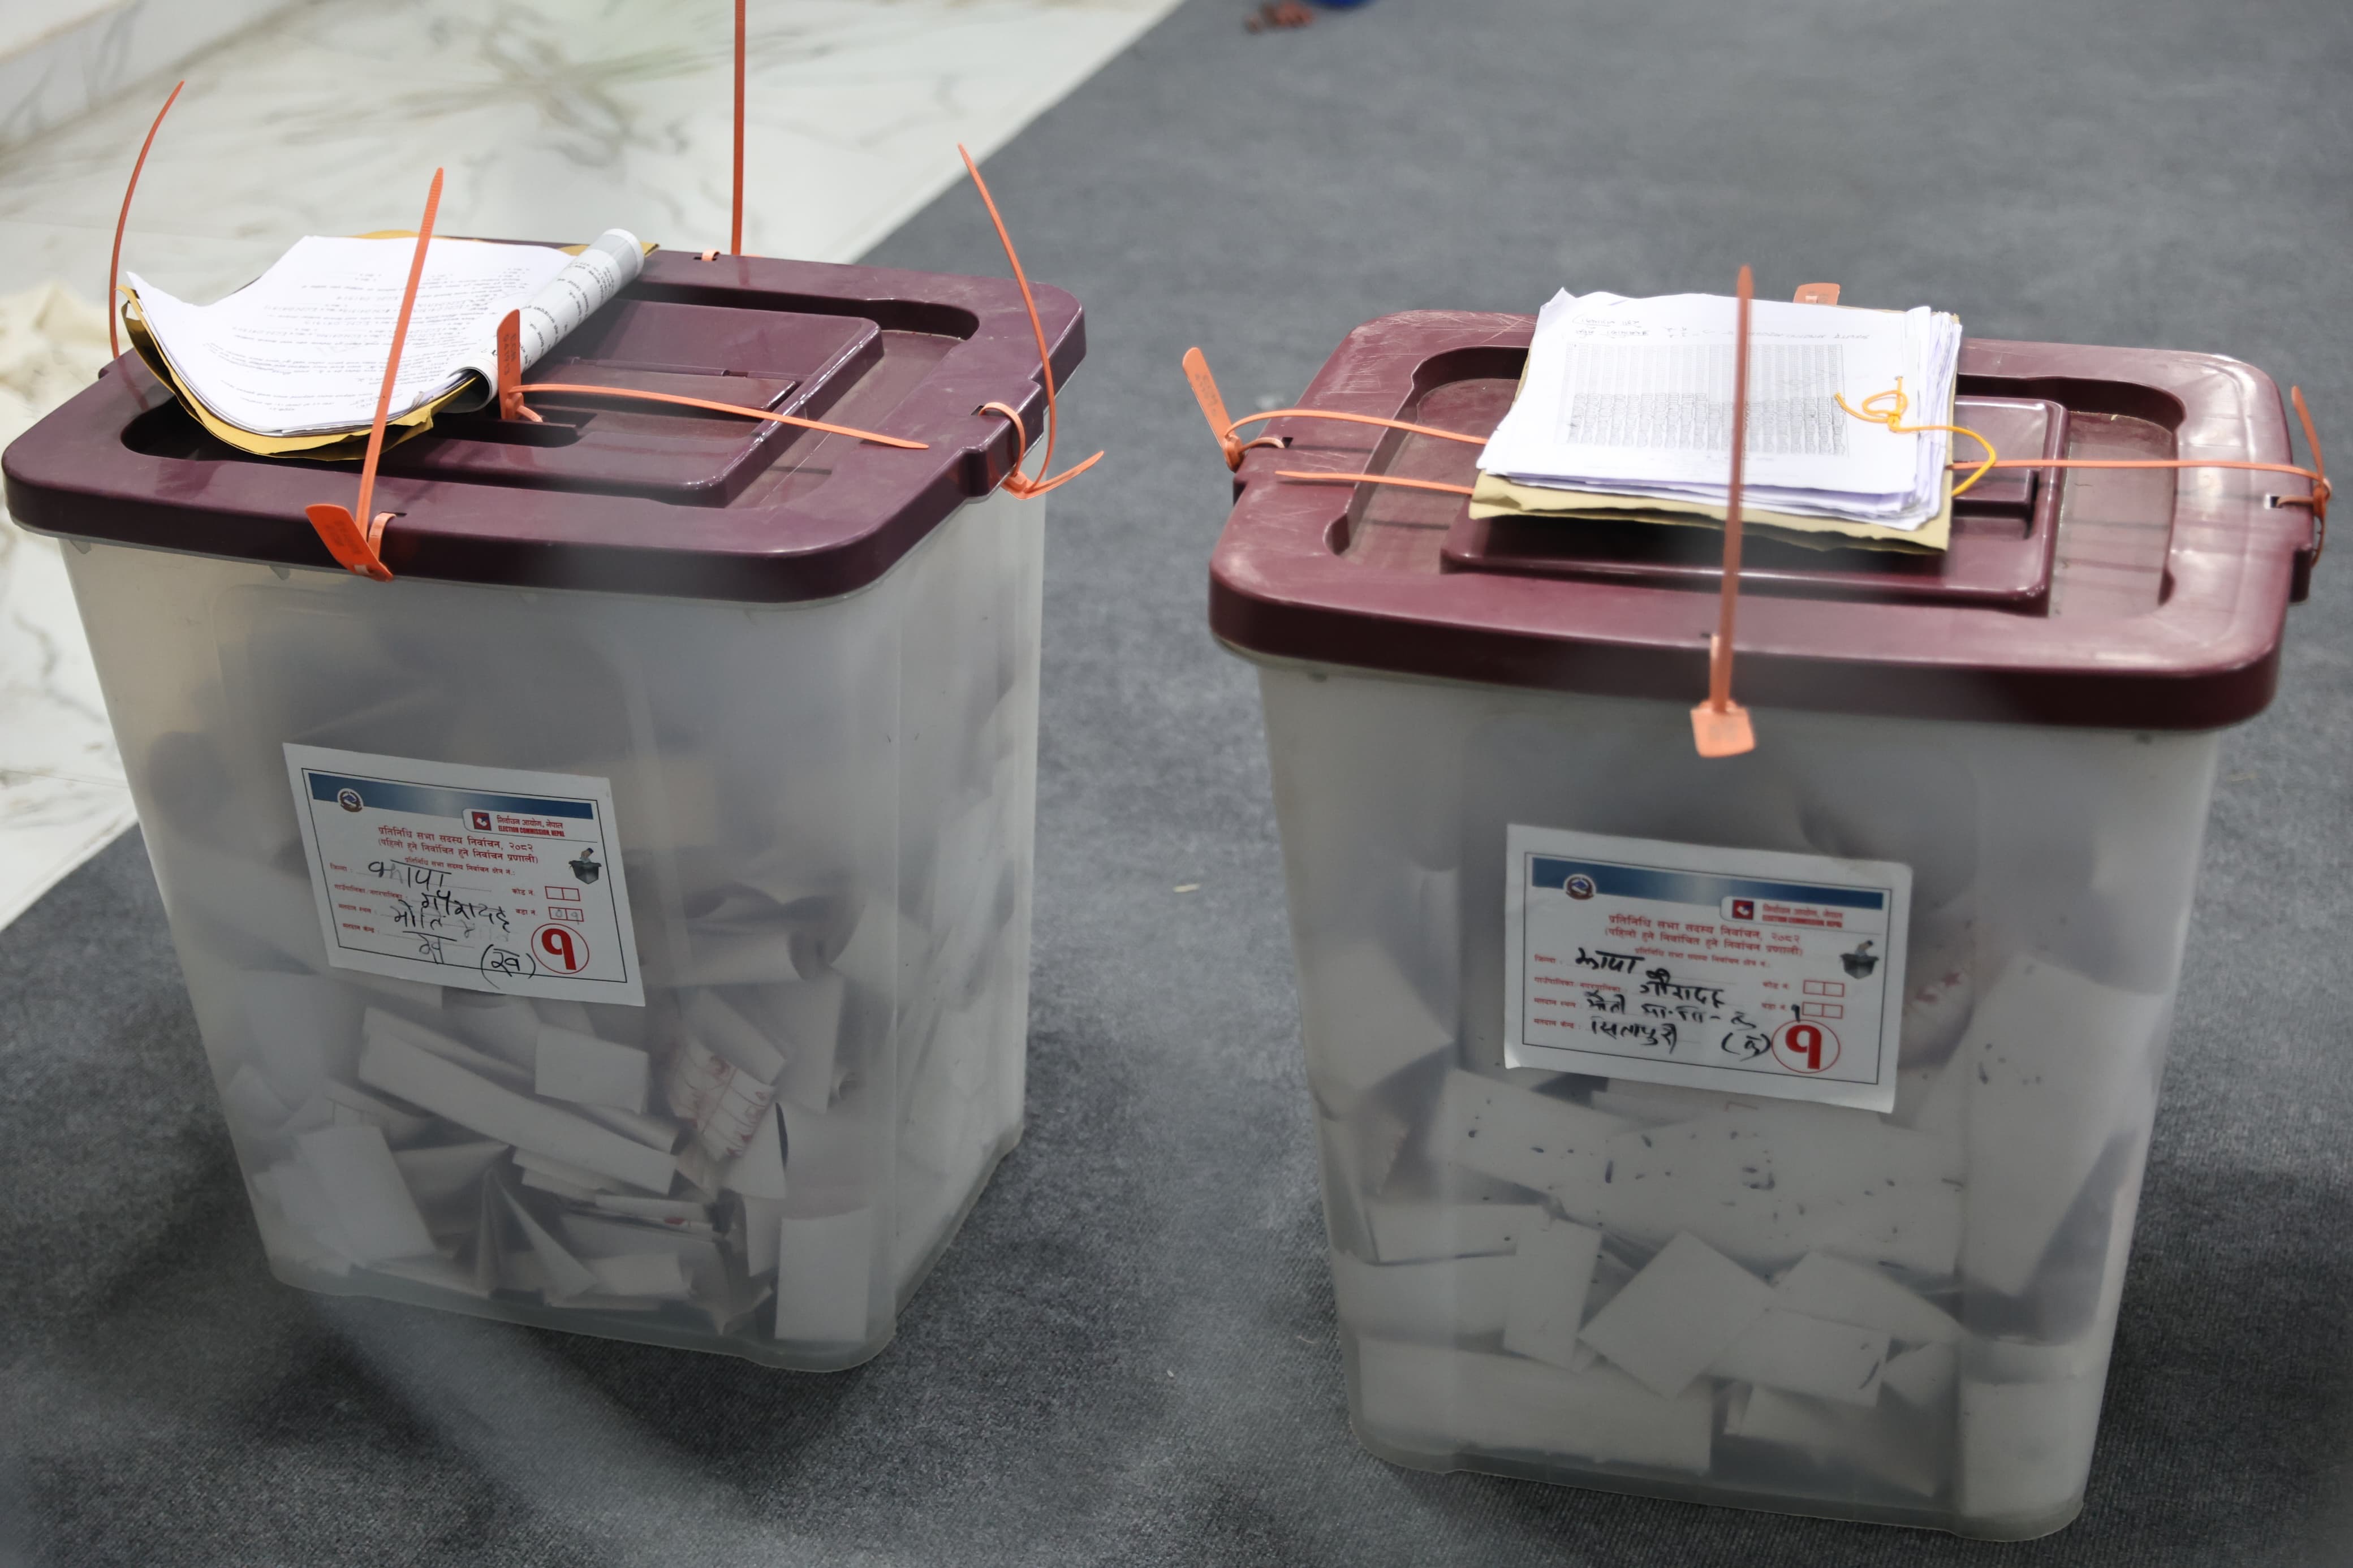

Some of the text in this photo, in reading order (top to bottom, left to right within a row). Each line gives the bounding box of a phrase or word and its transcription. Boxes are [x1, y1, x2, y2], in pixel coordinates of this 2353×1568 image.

[497, 815, 563, 829] निर्वाचन आयोग, नेपाल
[378, 825, 412, 839] प्रतिनिधि
[417, 831, 434, 842] सभा
[439, 835, 462, 845] सदस्य
[468, 836, 503, 850] निर्वाचन,
[378, 838, 538, 864] (पहिलो हुने निर्वाचित हुने निर्वाचन प्रणाली)
[404, 857, 429, 867] प्रतिनिधि
[466, 864, 489, 874] निर्वाचन
[1608, 914, 1651, 928] प्रतिनिधि
[1657, 920, 1679, 931] सभा
[1685, 924, 1714, 935] सदस्य
[1720, 925, 1762, 941] निर्वाचन,
[541, 928, 577, 970] १
[1605, 927, 1803, 957] (पहिलो हुने निर्वाचित हुने निर्वाचन प्रणाली)
[1785, 1024, 1822, 1070] १
